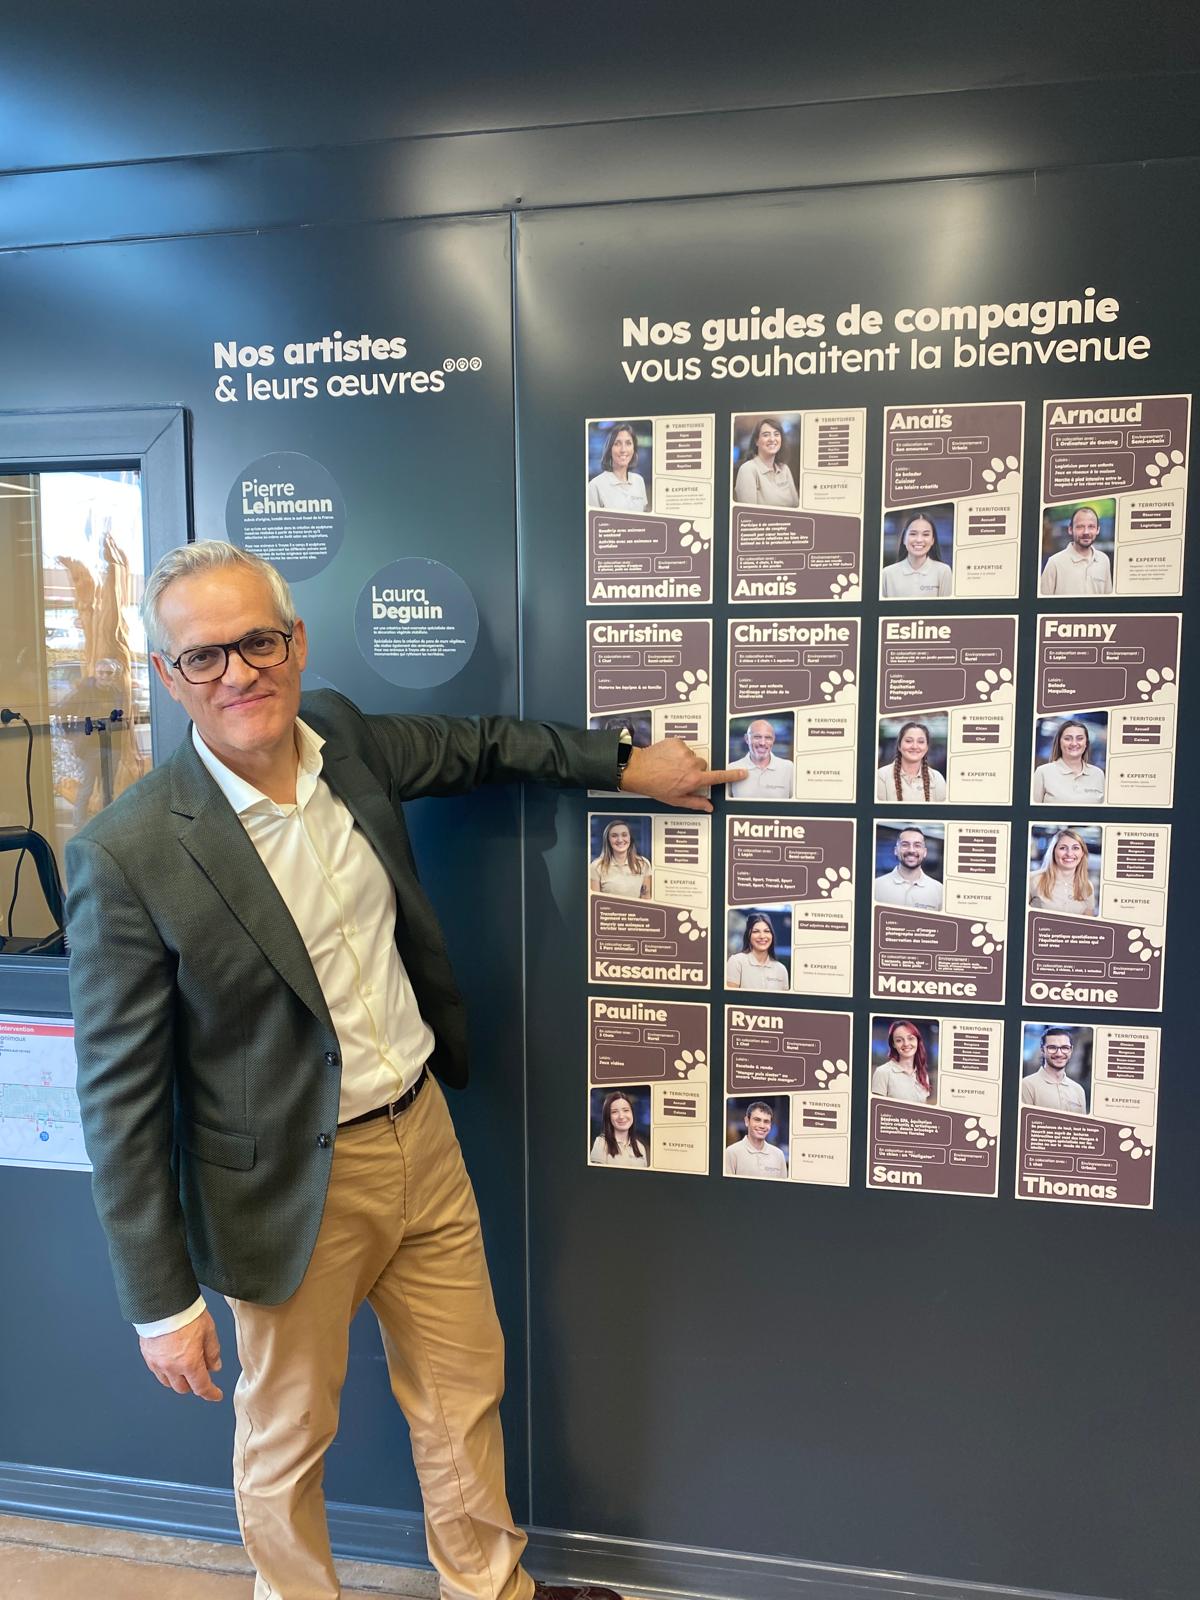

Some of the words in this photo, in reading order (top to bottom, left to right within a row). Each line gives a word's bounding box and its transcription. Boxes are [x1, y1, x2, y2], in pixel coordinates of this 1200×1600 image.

[622, 316, 692, 347] Nos
[701, 305, 826, 351] guides
[836, 303, 883, 336] de
[894, 287, 1120, 341] compagnie
[214, 341, 275, 369] Nos
[284, 331, 407, 365] artistes
[621, 357, 702, 383] vous
[710, 341, 900, 380] souhaitent
[910, 338, 942, 370] la
[953, 334, 1151, 368] bienvenue
[214, 375, 238, 403] &
[246, 372, 319, 401] leurs
[326, 369, 446, 397] œuvres
[890, 408, 952, 430] Anaïs
[1050, 402, 1142, 425] Arnaud
[242, 479, 295, 498] Pierre
[242, 496, 333, 515] Lehmann
[372, 585, 426, 602] Laura
[592, 578, 702, 598] Amandine
[734, 576, 798, 597] Anaïs
[372, 600, 443, 624] Deguin
[594, 624, 683, 642] Christine
[734, 622, 850, 646] Christophe
[886, 620, 952, 640] Esline
[1045, 620, 1117, 643] Fanny
[734, 820, 806, 838] Marine
[596, 961, 704, 982] Kassandra
[878, 976, 978, 996] Maxence
[1030, 982, 1119, 1004] Océane
[596, 1003, 668, 1022] Pauline
[732, 1010, 784, 1031] Ryan
[873, 1166, 922, 1184] Sam
[1022, 1176, 1118, 1199] Thomas
